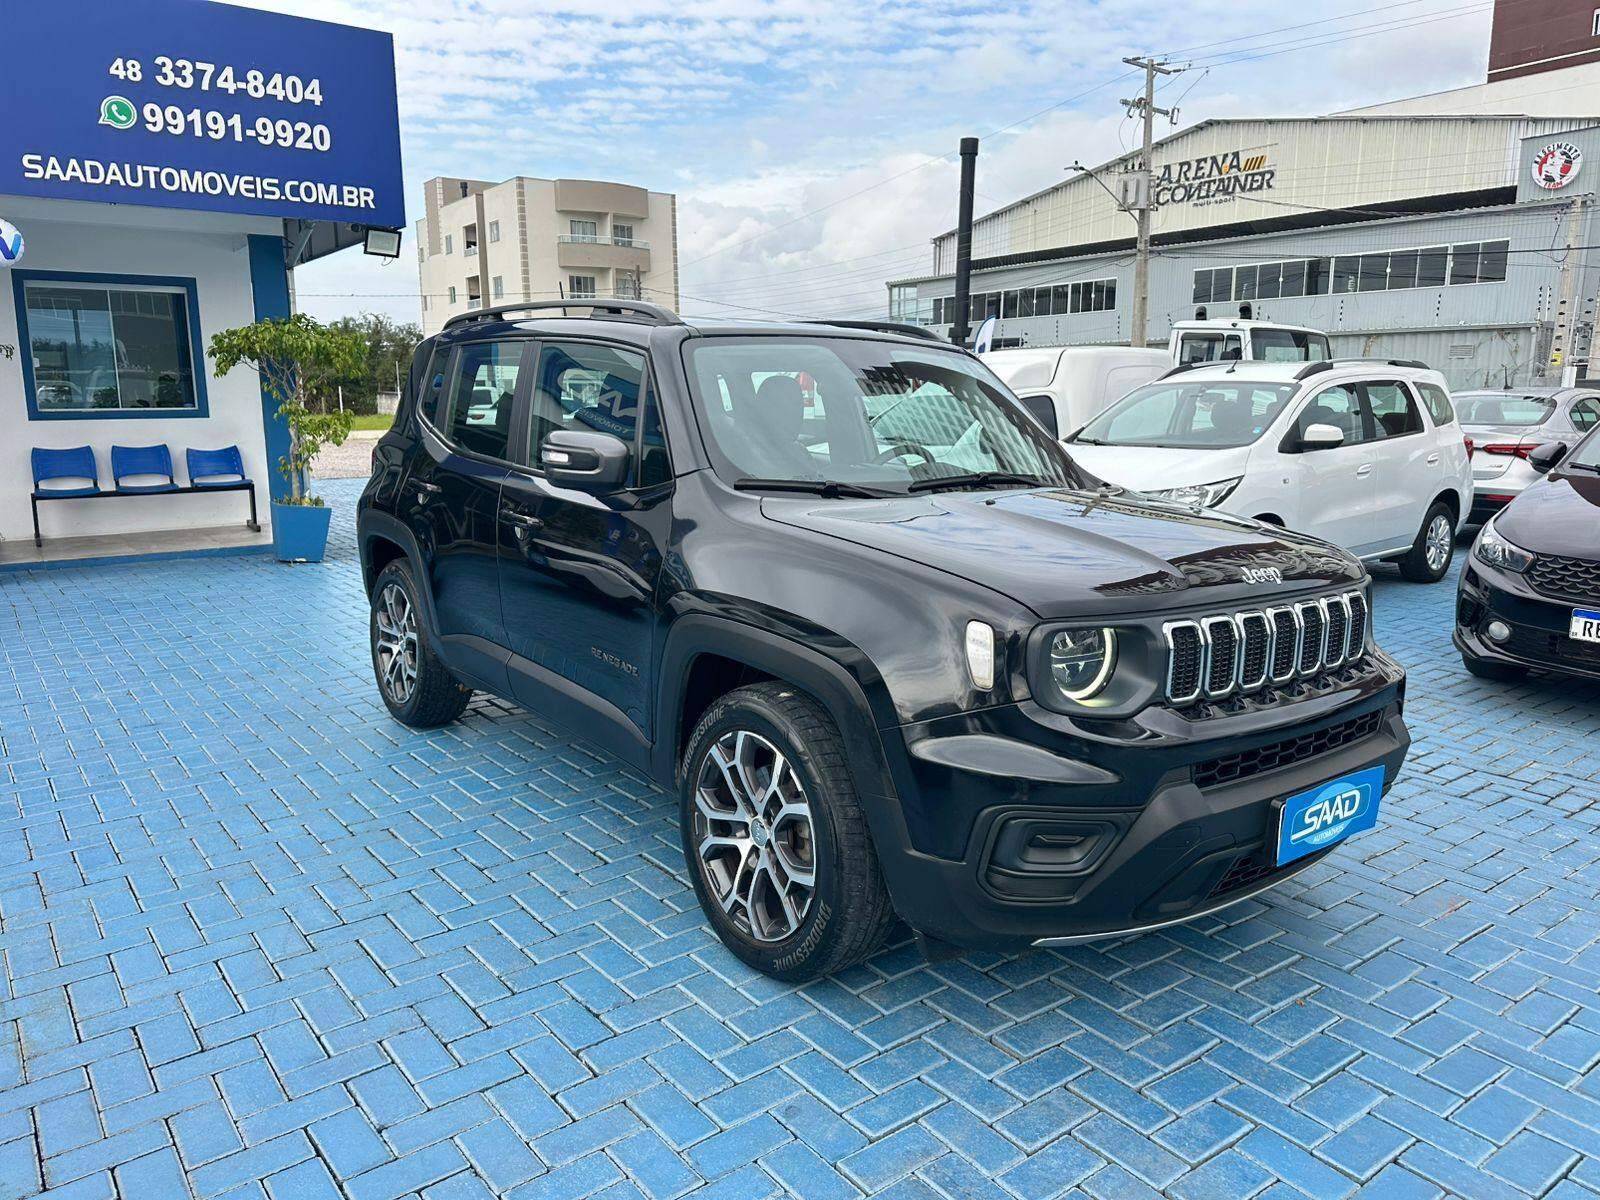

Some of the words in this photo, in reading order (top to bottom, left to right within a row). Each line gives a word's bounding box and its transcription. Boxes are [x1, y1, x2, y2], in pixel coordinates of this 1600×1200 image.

[109, 58, 142, 82] 48
[154, 56, 323, 106] 3374-8404
[143, 103, 331, 152] 99191-9920
[22, 154, 376, 209] SAADAUTOMOVEIS.COM.BR
[1156, 170, 1275, 206] CONTAINER
[1157, 151, 1242, 188] ARENA
[1240, 565, 1283, 585] Jeep
[591, 646, 640, 678] RENEGADE
[1291, 789, 1361, 840] SAAD
